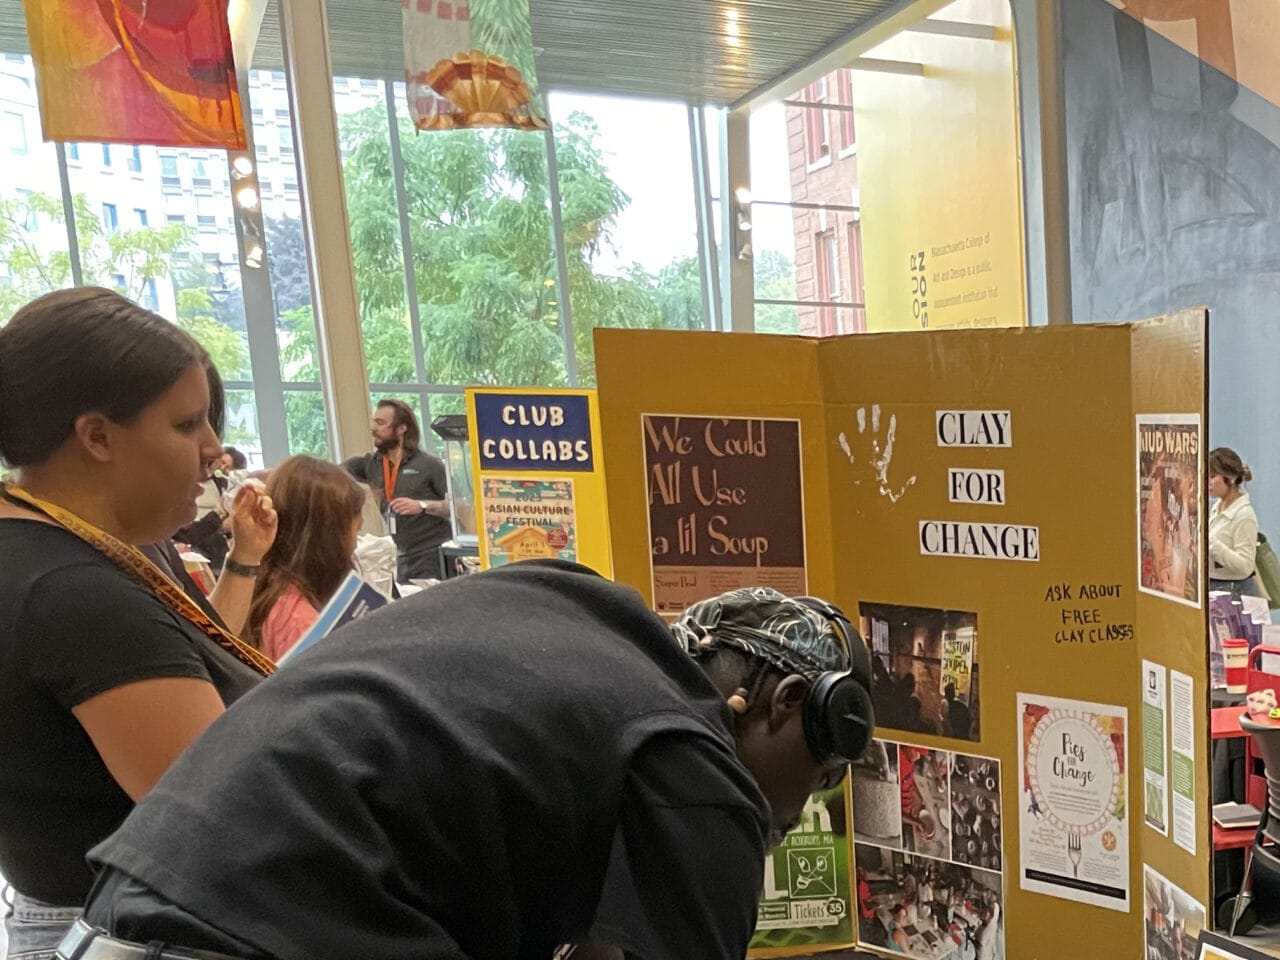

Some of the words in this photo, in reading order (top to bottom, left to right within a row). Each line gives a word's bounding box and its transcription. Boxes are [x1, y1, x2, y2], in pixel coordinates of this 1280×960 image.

[502, 405, 564, 427] CLUB
[644, 416, 694, 455] We
[704, 418, 767, 457] Could
[938, 412, 1009, 445] CLAY
[483, 438, 589, 462] COLLABS
[1164, 431, 1198, 455] WARS
[650, 460, 681, 505] All
[692, 465, 747, 506] Use
[951, 472, 1003, 503] FOR
[489, 504, 520, 513] ASIAN
[522, 506, 570, 515] CULTURE
[506, 517, 553, 527] FESTIVAL
[653, 537, 668, 554] a
[678, 512, 696, 556] lil
[708, 515, 769, 567] Soup
[921, 522, 1039, 559] CHANGE
[1045, 584, 1071, 602] ASK
[1079, 584, 1122, 600] ABOUT
[1062, 609, 1101, 625] FREE
[1055, 630, 1086, 644] CLAY
[1089, 624, 1134, 644] CLASSES
[1062, 733, 1087, 762] Pies
[1053, 756, 1096, 788] Change
[794, 902, 825, 919] Tickets
[829, 902, 842, 914] 35
